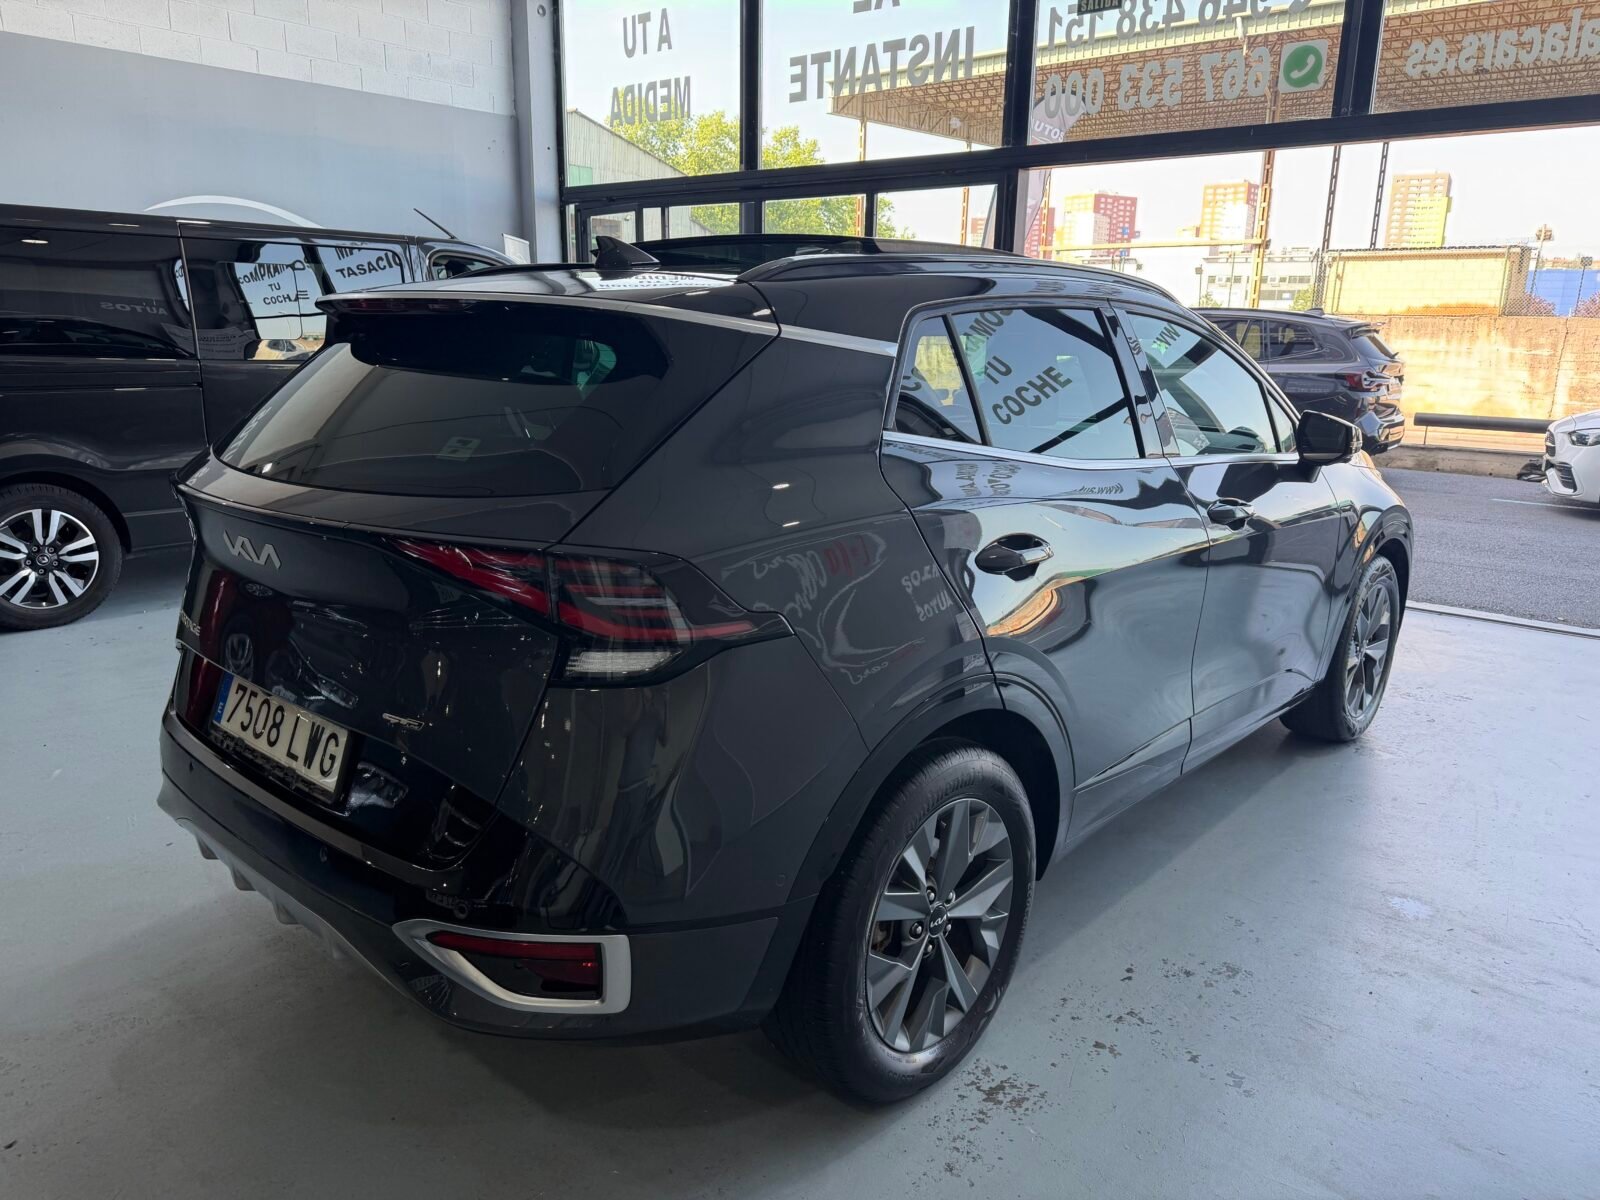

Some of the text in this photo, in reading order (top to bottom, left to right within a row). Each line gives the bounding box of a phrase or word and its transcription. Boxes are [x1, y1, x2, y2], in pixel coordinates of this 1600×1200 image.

[1080, 0, 1119, 12] SALIDA
[1032, 120, 1064, 142] UTOS
[268, 282, 281, 292] TU
[985, 355, 1013, 385] TU
[992, 366, 1073, 425] COCHE
[226, 683, 285, 747] 7508
[286, 715, 339, 777] LWG
